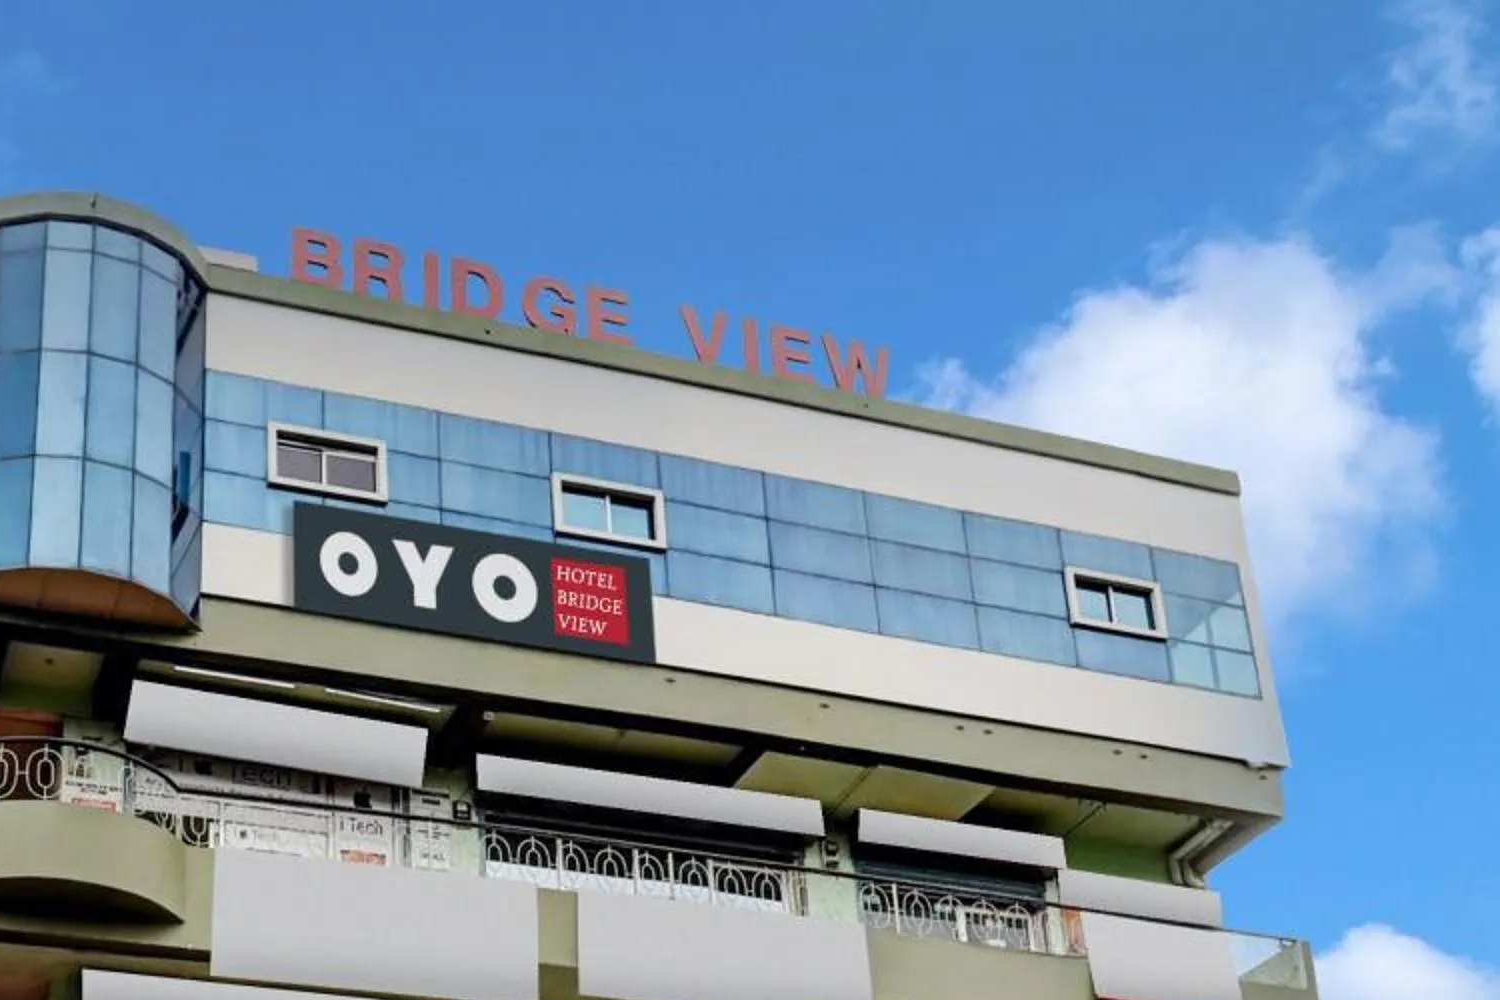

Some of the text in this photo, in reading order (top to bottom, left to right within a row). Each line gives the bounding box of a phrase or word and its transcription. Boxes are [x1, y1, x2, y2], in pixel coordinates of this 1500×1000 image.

[290, 225, 891, 398] BRIDGE VIEW
[318, 530, 539, 624] OYO
[556, 565, 618, 592] HOTEL
[557, 589, 624, 616] BRIDGE
[557, 612, 608, 636] VIEW
